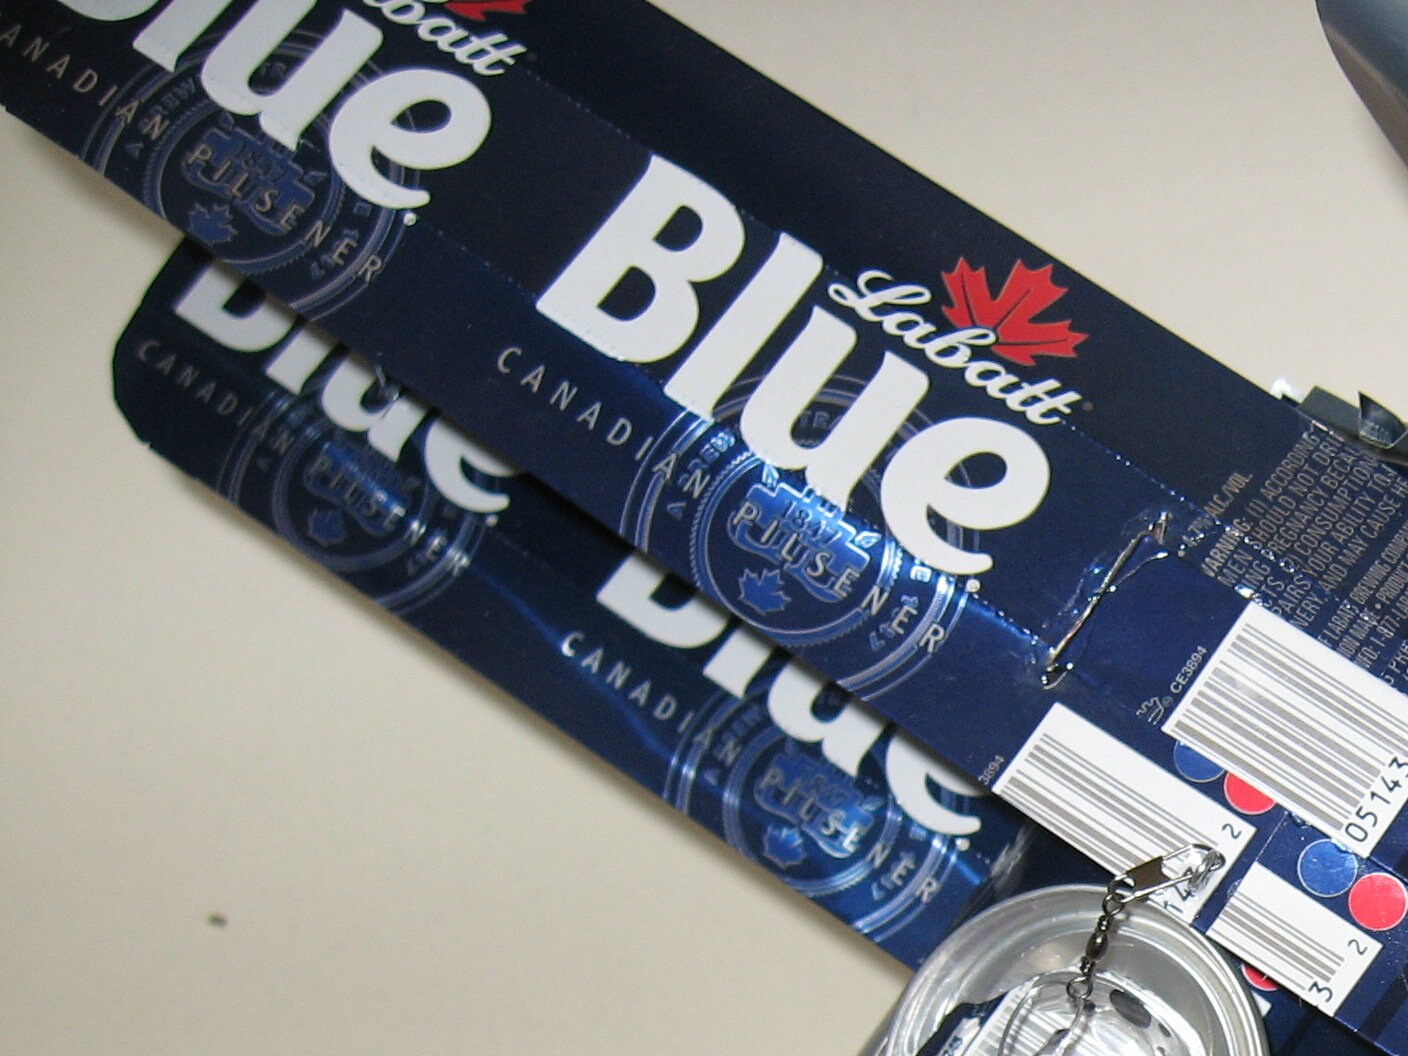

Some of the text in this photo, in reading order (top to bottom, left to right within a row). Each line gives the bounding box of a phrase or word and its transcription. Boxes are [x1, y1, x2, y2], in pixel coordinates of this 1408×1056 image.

[0, 28, 385, 283] ANADIAN PILSENER
[535, 152, 1051, 574] Blue
[827, 269, 1081, 425] Labatt
[136, 338, 471, 577] CANADIAN PILSENER
[496, 345, 946, 654] CANADIAN PILSENER
[1257, 427, 1322, 504] ACCORDING
[1291, 451, 1379, 559] CONSUMPTION
[1244, 491, 1298, 553] SHOULD
[1287, 462, 1321, 499] NOT
[1260, 482, 1330, 565] PREGNANCY
[1301, 538, 1340, 582] YOUR
[1328, 489, 1378, 546] ABILITY
[1316, 559, 1349, 595] AND
[1336, 533, 1370, 568] MAY
[1357, 492, 1400, 541] CAUSE
[1348, 557, 1391, 606] BREWING
[1167, 642, 1210, 695] CE3894
[560, 631, 941, 902] CANADIAN PILSENER
[1219, 819, 1243, 841] 2
[1347, 936, 1369, 957] 2
